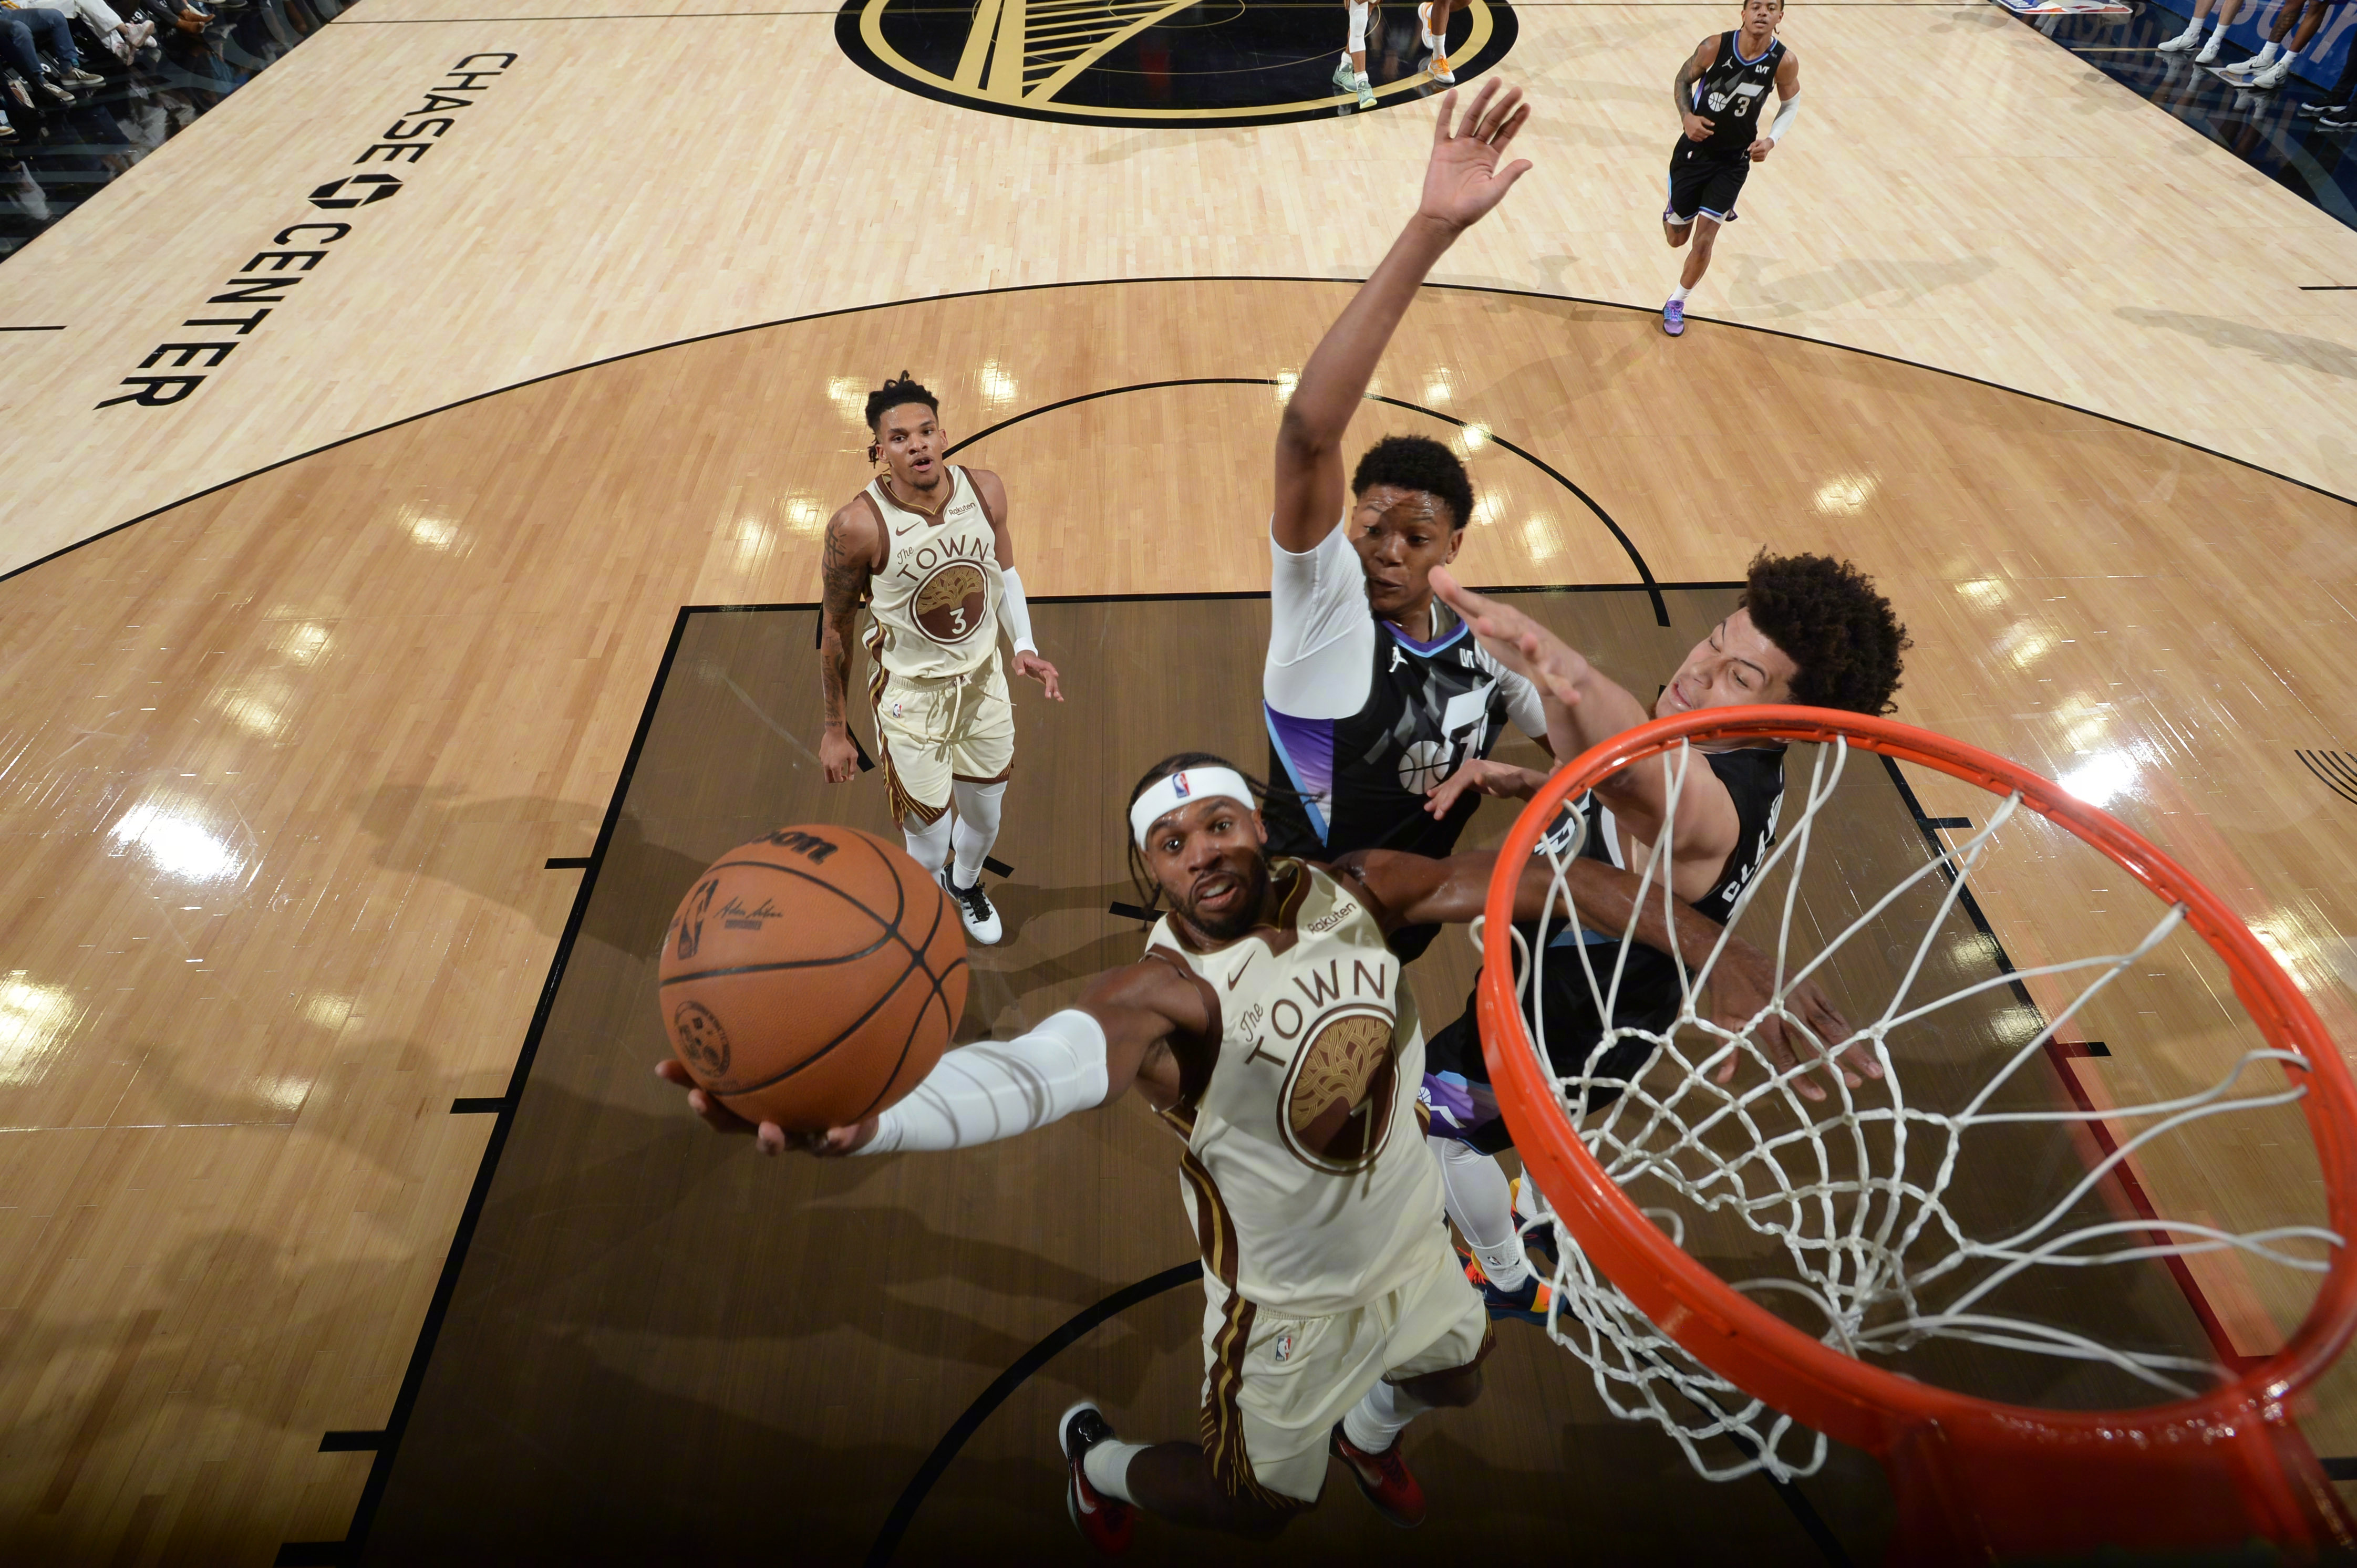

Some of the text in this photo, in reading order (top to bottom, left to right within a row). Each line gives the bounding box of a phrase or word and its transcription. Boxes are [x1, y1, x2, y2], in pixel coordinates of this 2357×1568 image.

[1734, 97, 1750, 117] 3
[94, 54, 518, 410] CHASE CENTER
[948, 502, 976, 515] Rakuten
[897, 546, 914, 565] The
[897, 535, 989, 581] TOWN
[949, 607, 966, 635] 3
[1307, 902, 1357, 934] Rakuten
[1240, 1003, 1263, 1042] The
[1245, 959, 1385, 1068] TOWN
[1349, 1096, 1373, 1155] 7
